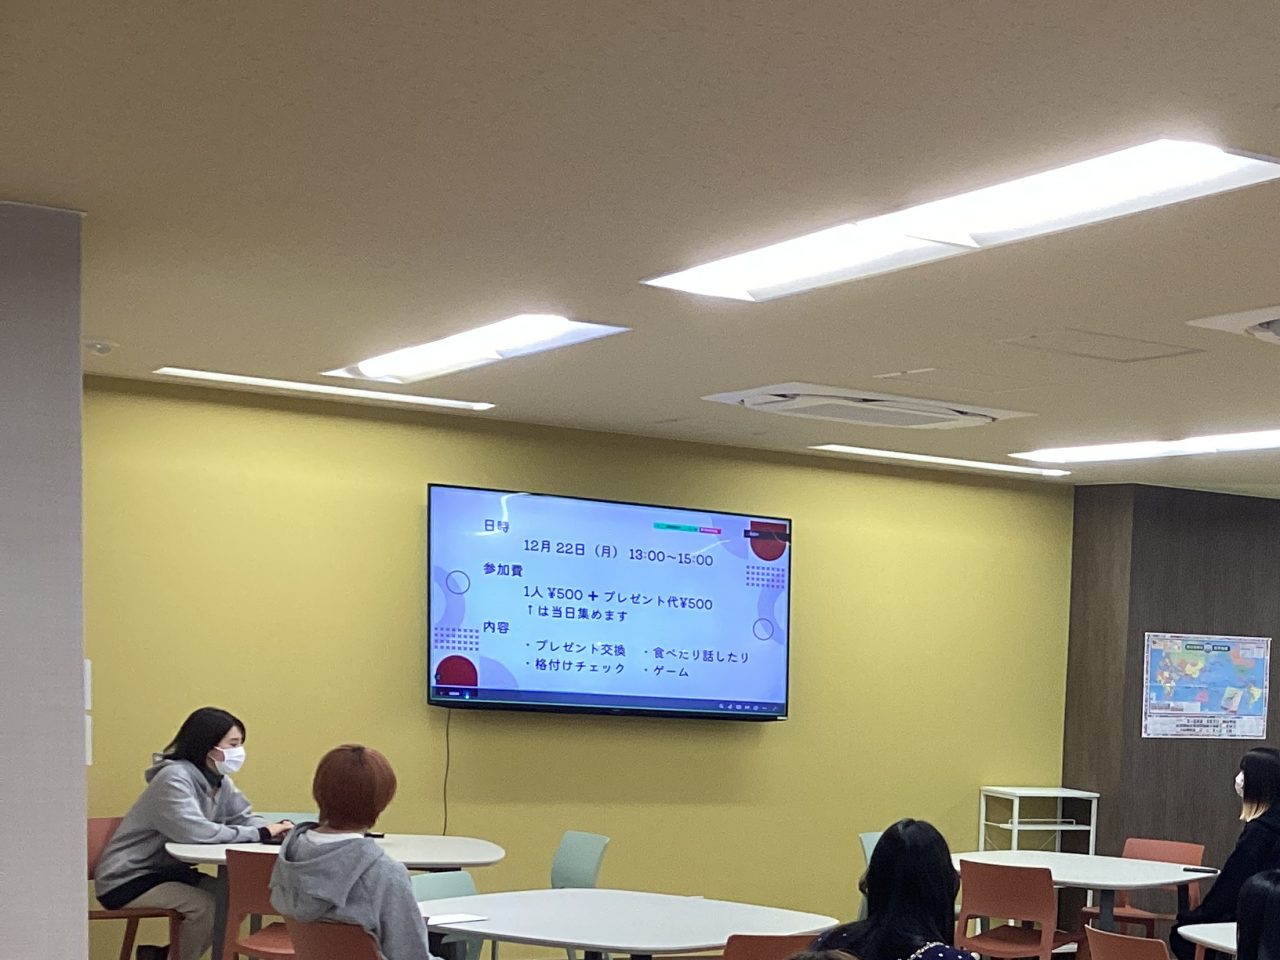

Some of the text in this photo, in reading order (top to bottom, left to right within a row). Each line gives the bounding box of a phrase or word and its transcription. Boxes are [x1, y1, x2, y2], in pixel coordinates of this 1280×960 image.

[484, 519, 510, 533] 日時
[524, 539, 551, 553] 12月
[556, 542, 585, 556] 22日
[483, 562, 523, 577] 参加費
[483, 621, 510, 634] 内容
